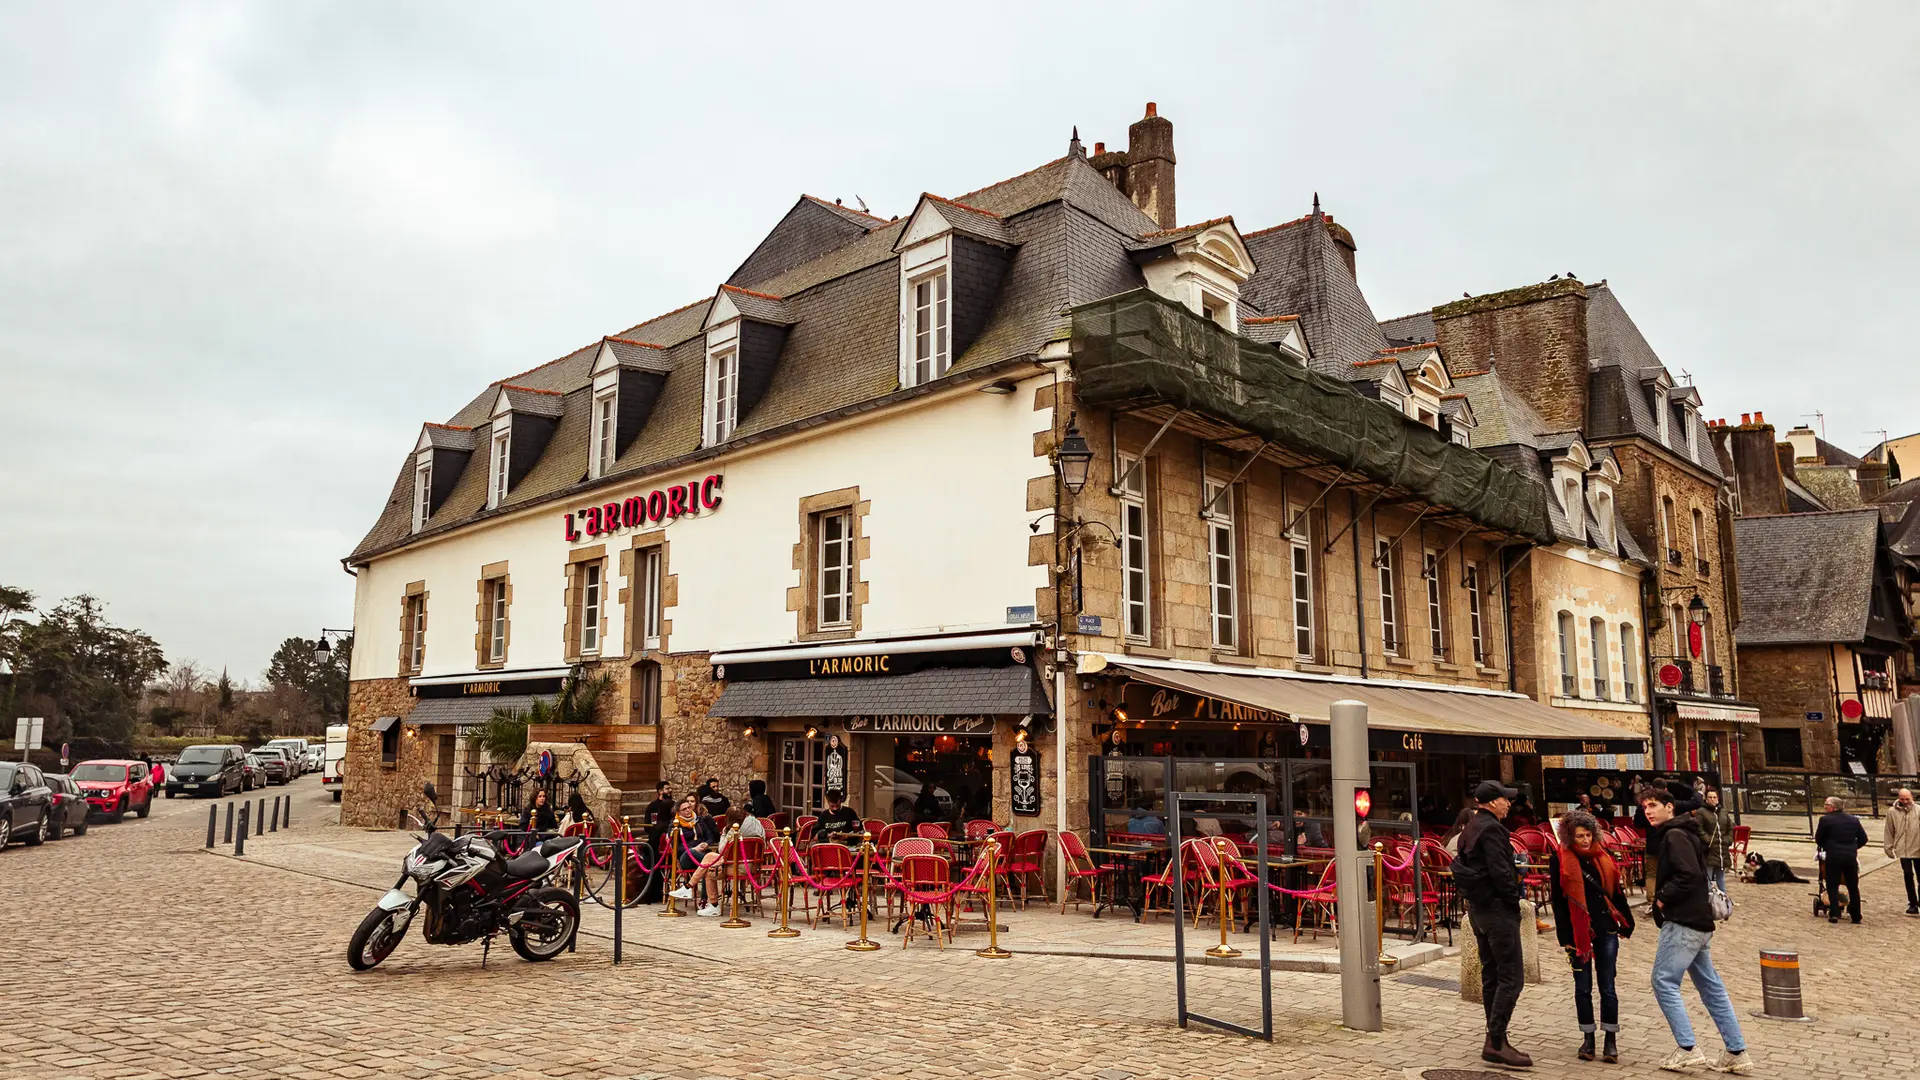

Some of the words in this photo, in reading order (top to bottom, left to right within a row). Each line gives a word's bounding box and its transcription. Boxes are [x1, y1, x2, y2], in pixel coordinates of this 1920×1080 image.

[810, 655, 889, 675] L'ARMORIC
[463, 681, 500, 694] L'ARMORIC
[1151, 689, 1180, 717] Bar
[850, 715, 868, 730] Bar
[874, 714, 945, 731] L'ARMORIC
[1402, 734, 1423, 750] Café
[1497, 738, 1537, 754] L'ARMORIC
